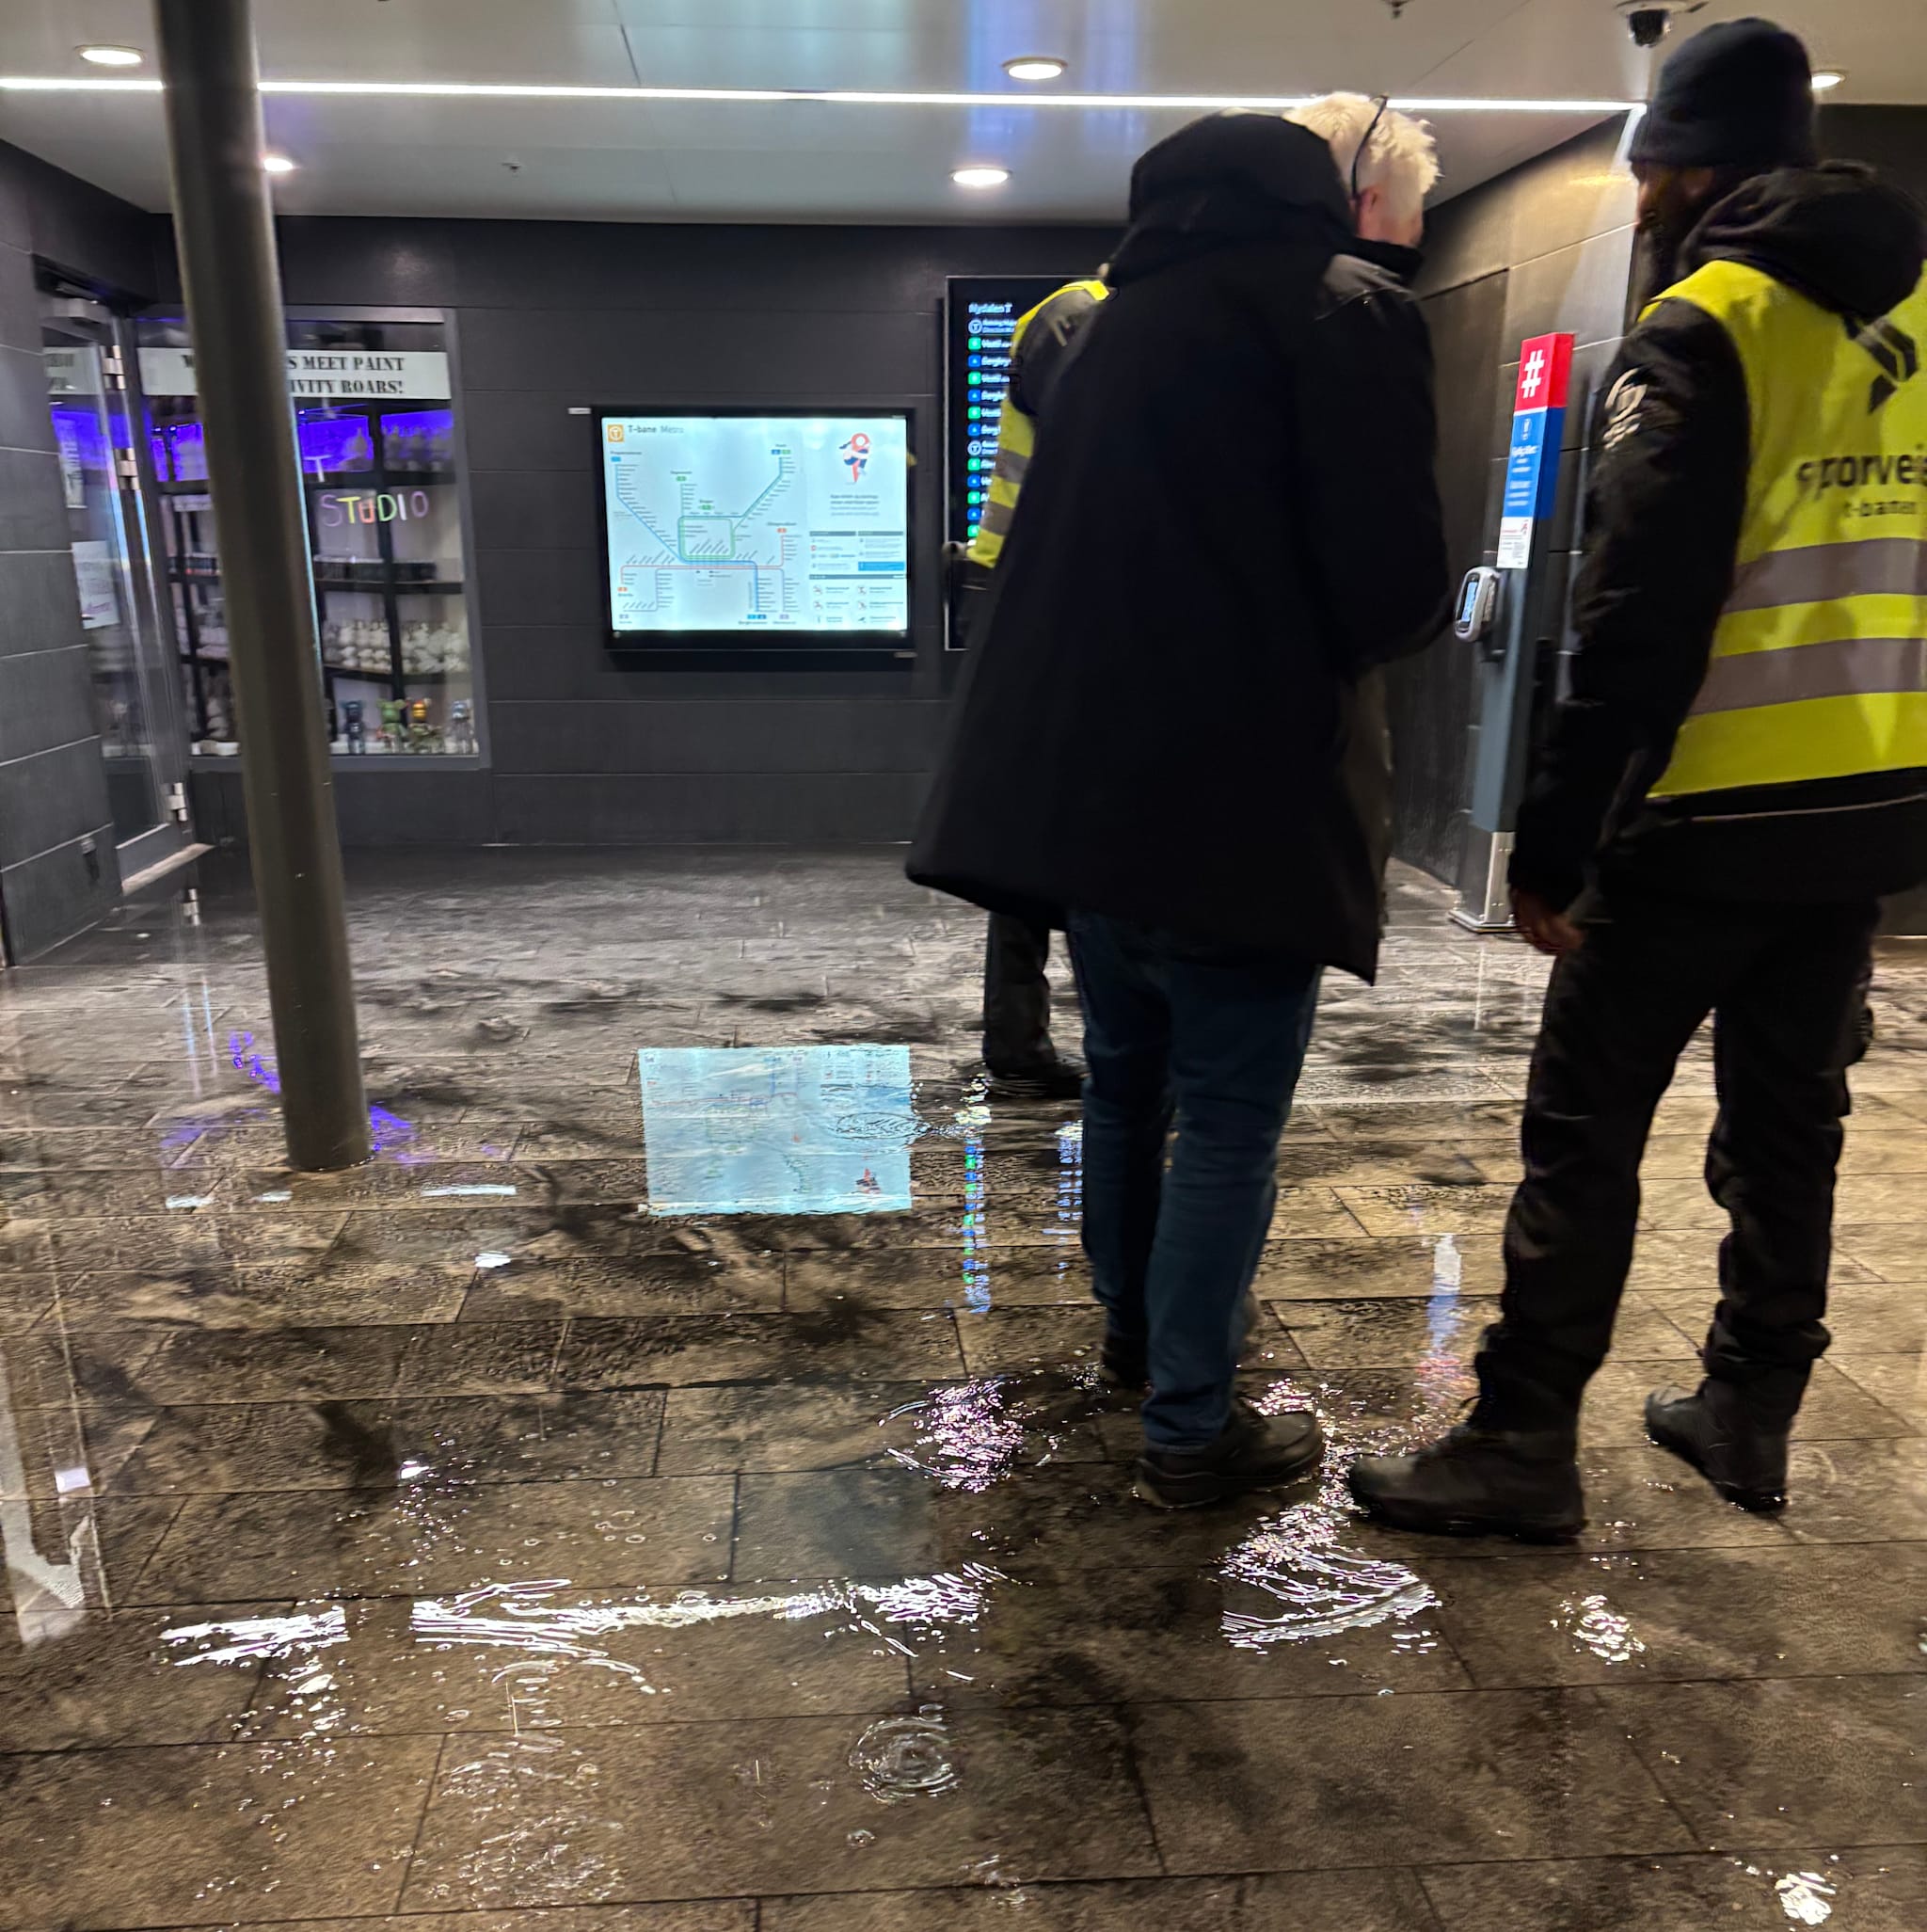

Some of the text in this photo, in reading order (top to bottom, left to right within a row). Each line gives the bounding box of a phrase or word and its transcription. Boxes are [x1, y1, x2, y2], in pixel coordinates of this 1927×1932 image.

[302, 356, 347, 371] MEET
[353, 357, 406, 372] PAINT
[290, 379, 404, 394] IVITY ROARS!
[628, 424, 658, 434] T-bane
[1795, 443, 1927, 501] sporvei
[320, 489, 429, 527] STUDIO
